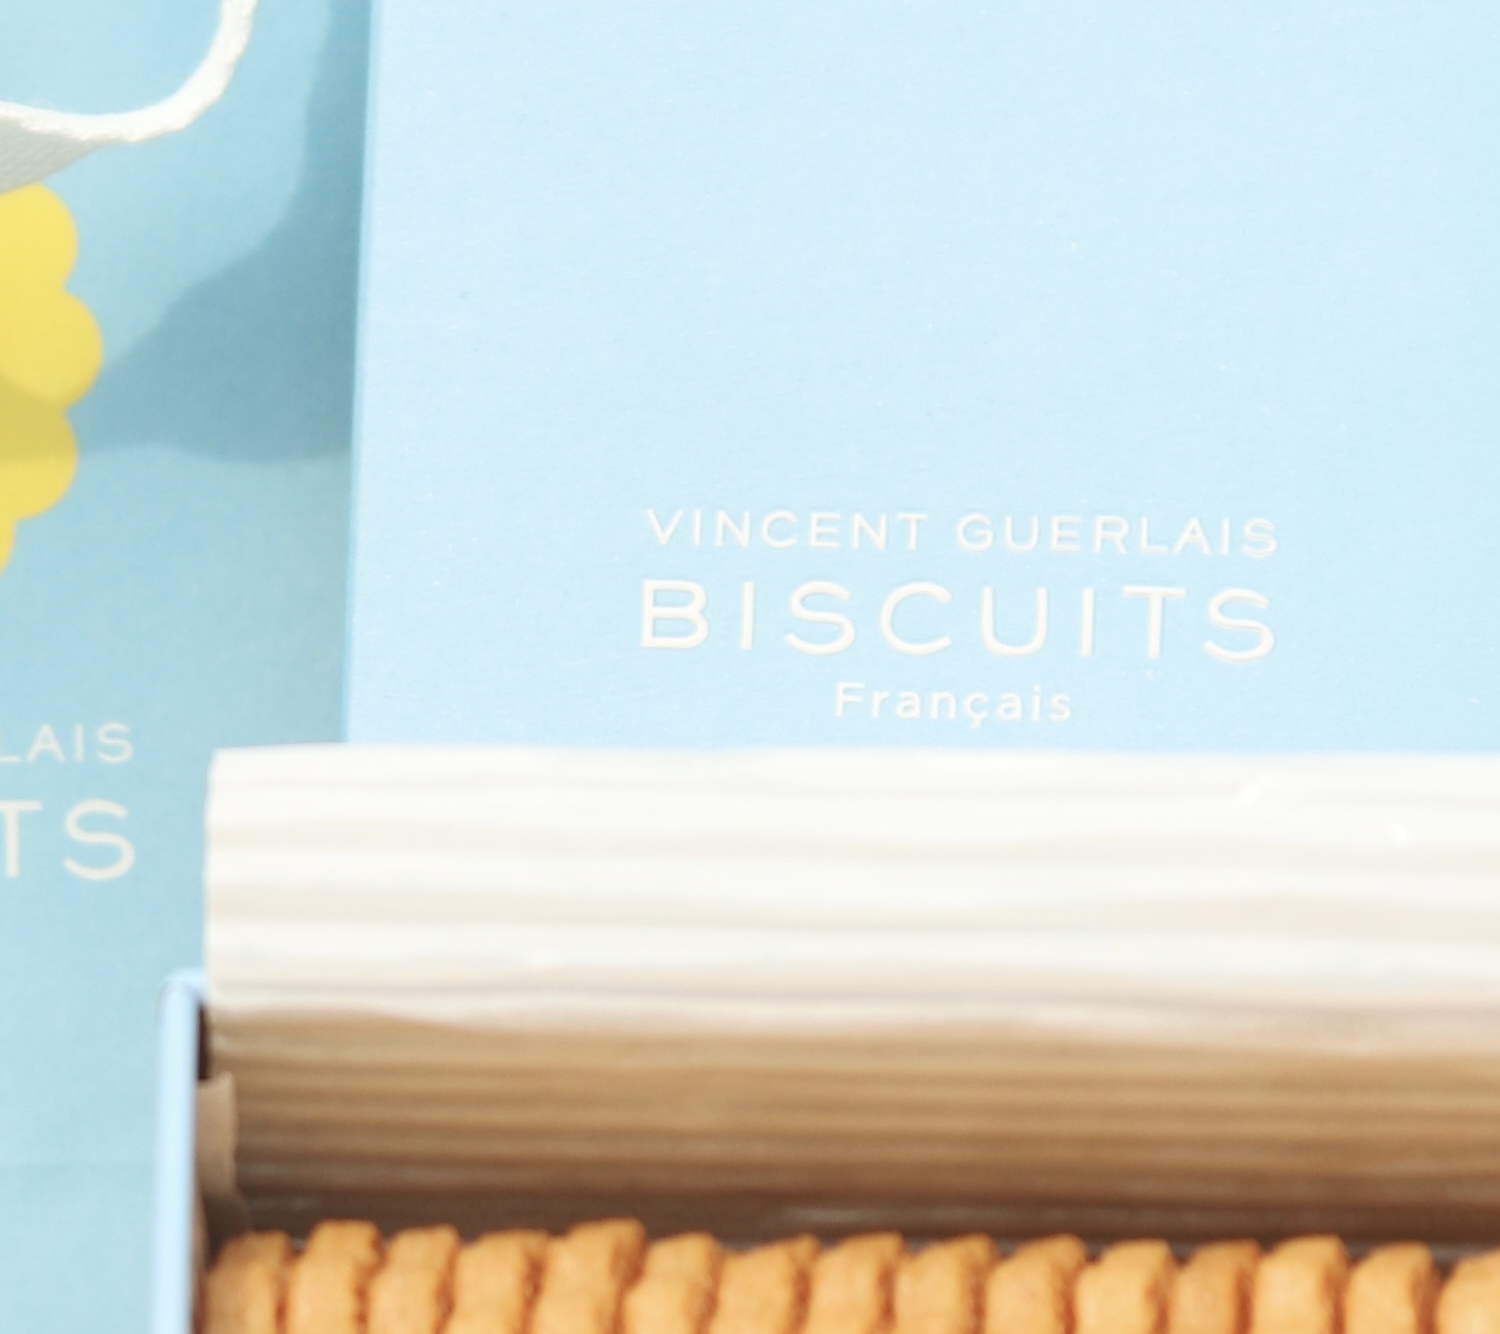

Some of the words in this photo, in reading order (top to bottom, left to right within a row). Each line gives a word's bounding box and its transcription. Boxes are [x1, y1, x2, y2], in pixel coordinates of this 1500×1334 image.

[646, 509, 929, 551] VINCENT
[955, 512, 1279, 560] GUERLAIS
[639, 579, 1275, 665] BISCUITS
[833, 681, 1072, 730] Français
